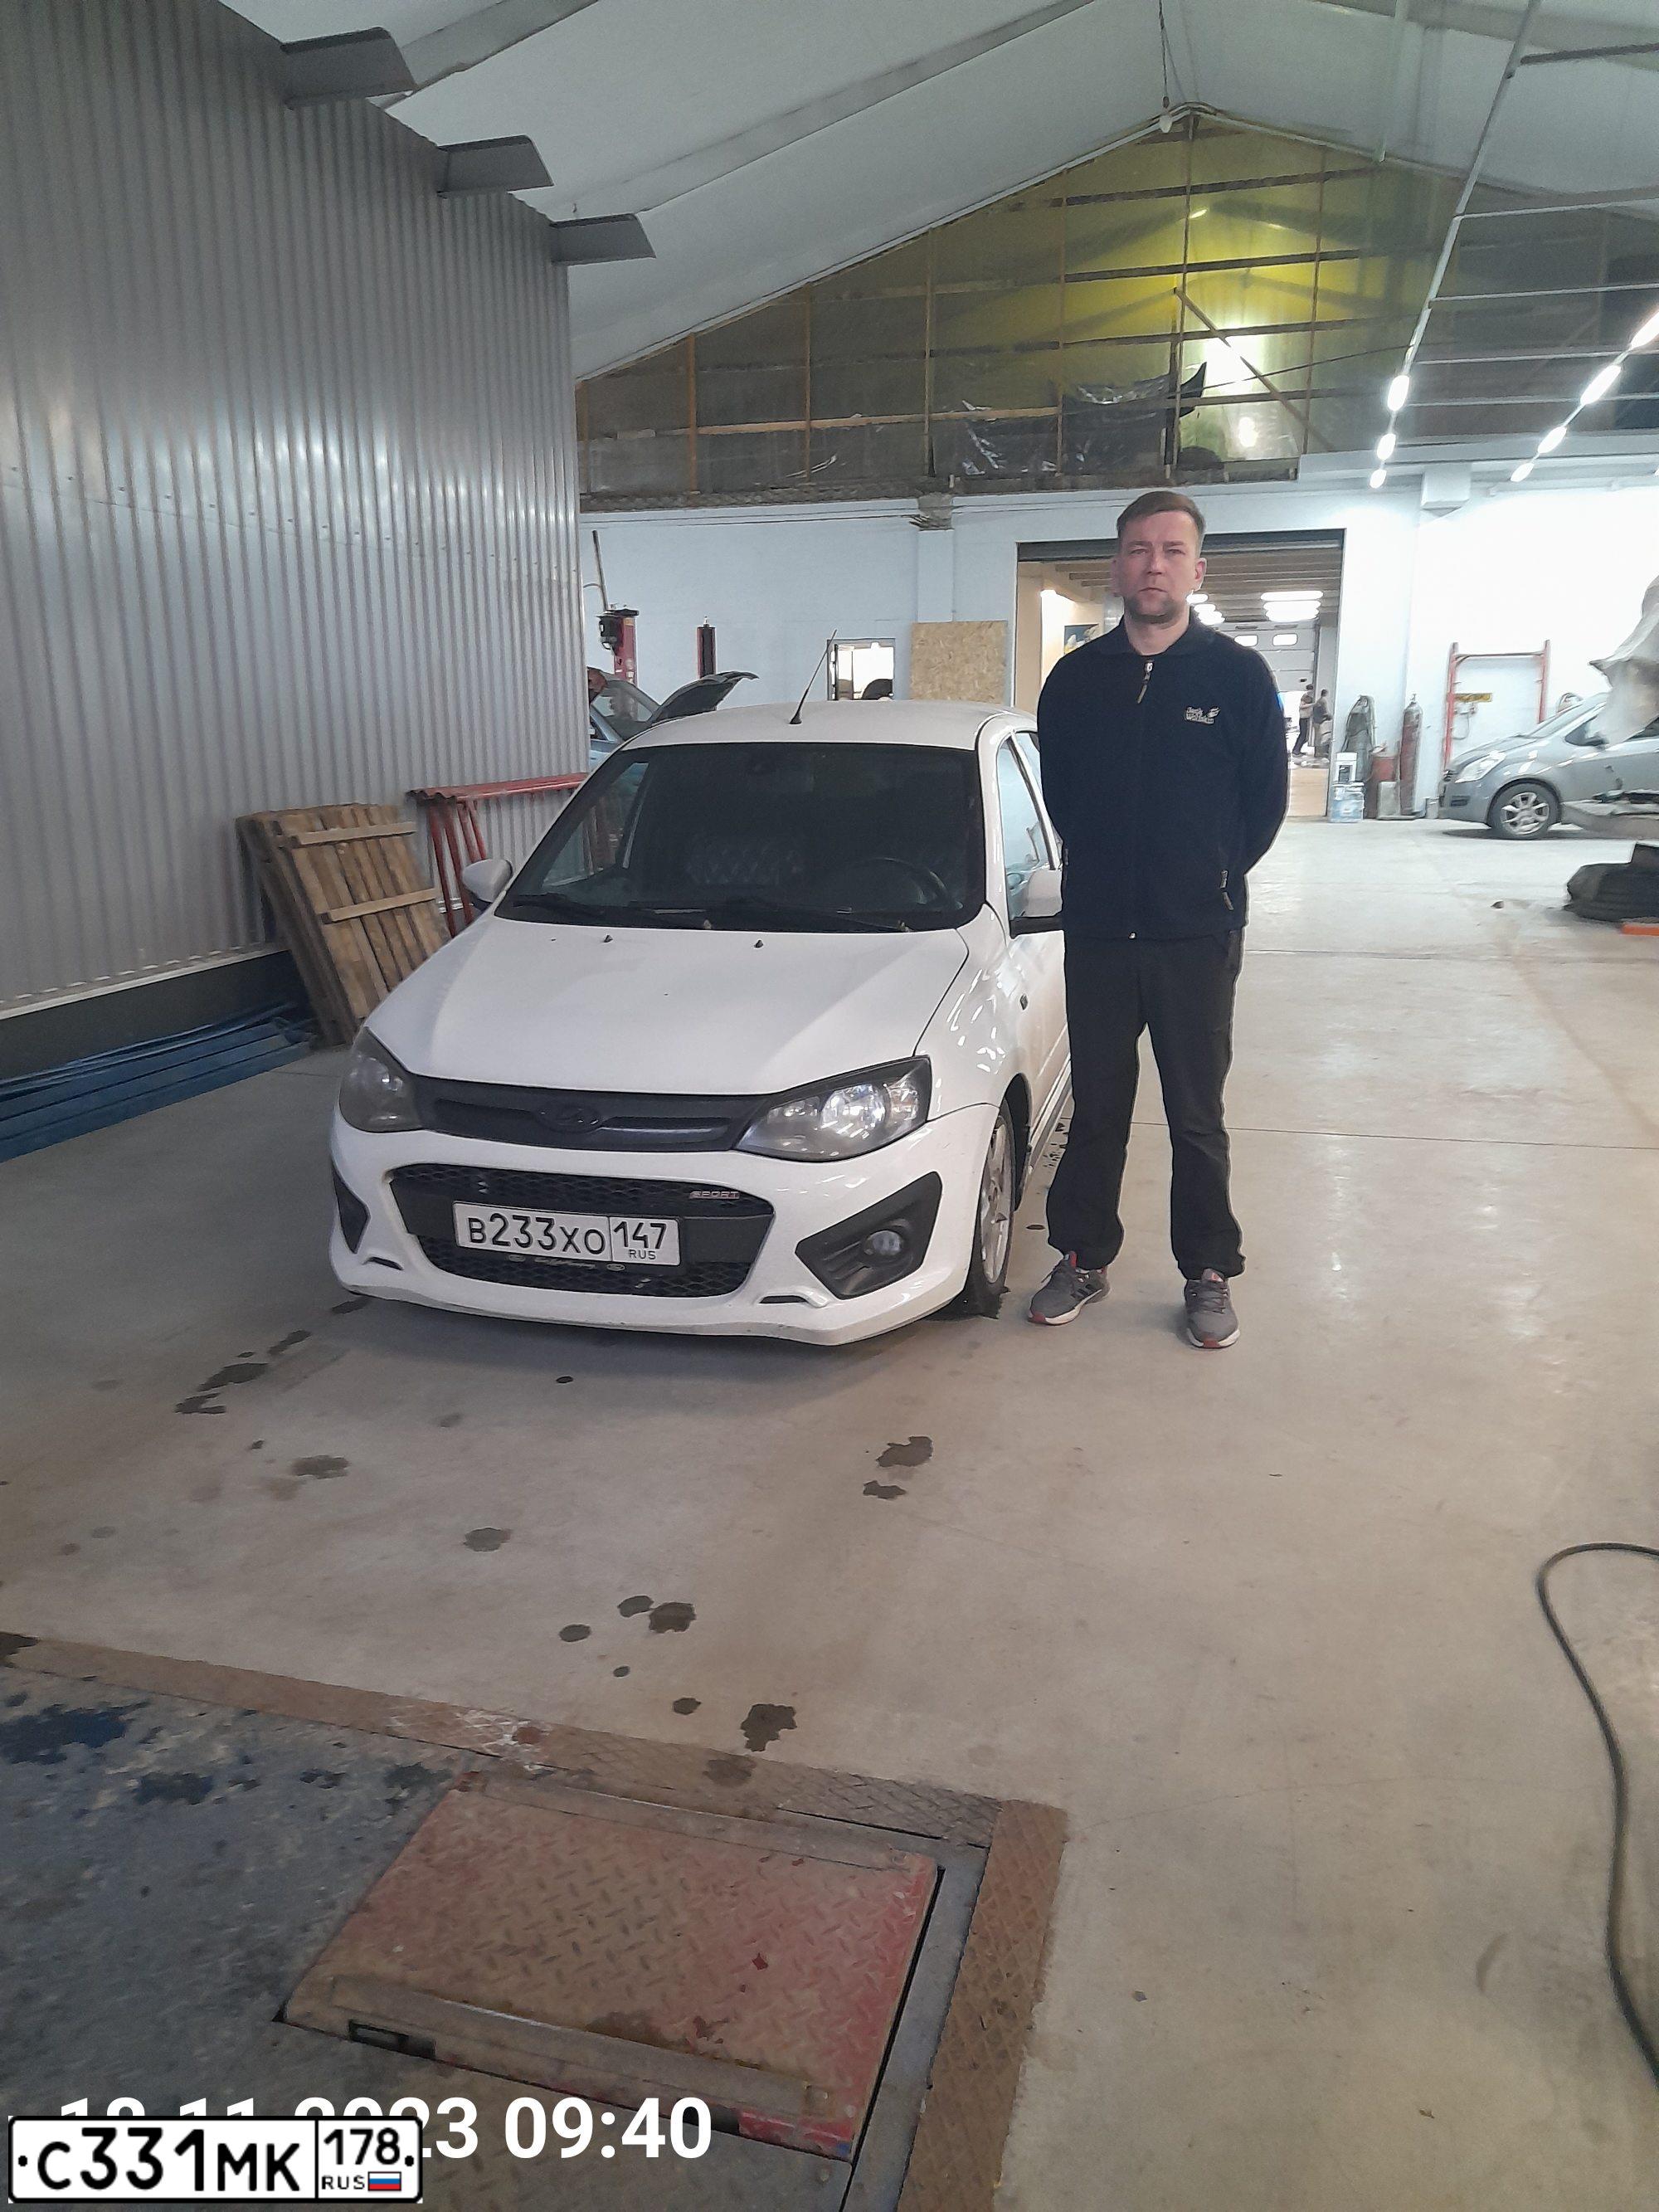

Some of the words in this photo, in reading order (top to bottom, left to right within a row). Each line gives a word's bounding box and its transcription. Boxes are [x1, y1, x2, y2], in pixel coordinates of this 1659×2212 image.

[689, 1191, 740, 1200] SPORT
[468, 1213, 606, 1255] В233ХО
[614, 1221, 667, 1250] 147
[629, 1250, 656, 1259] RUS
